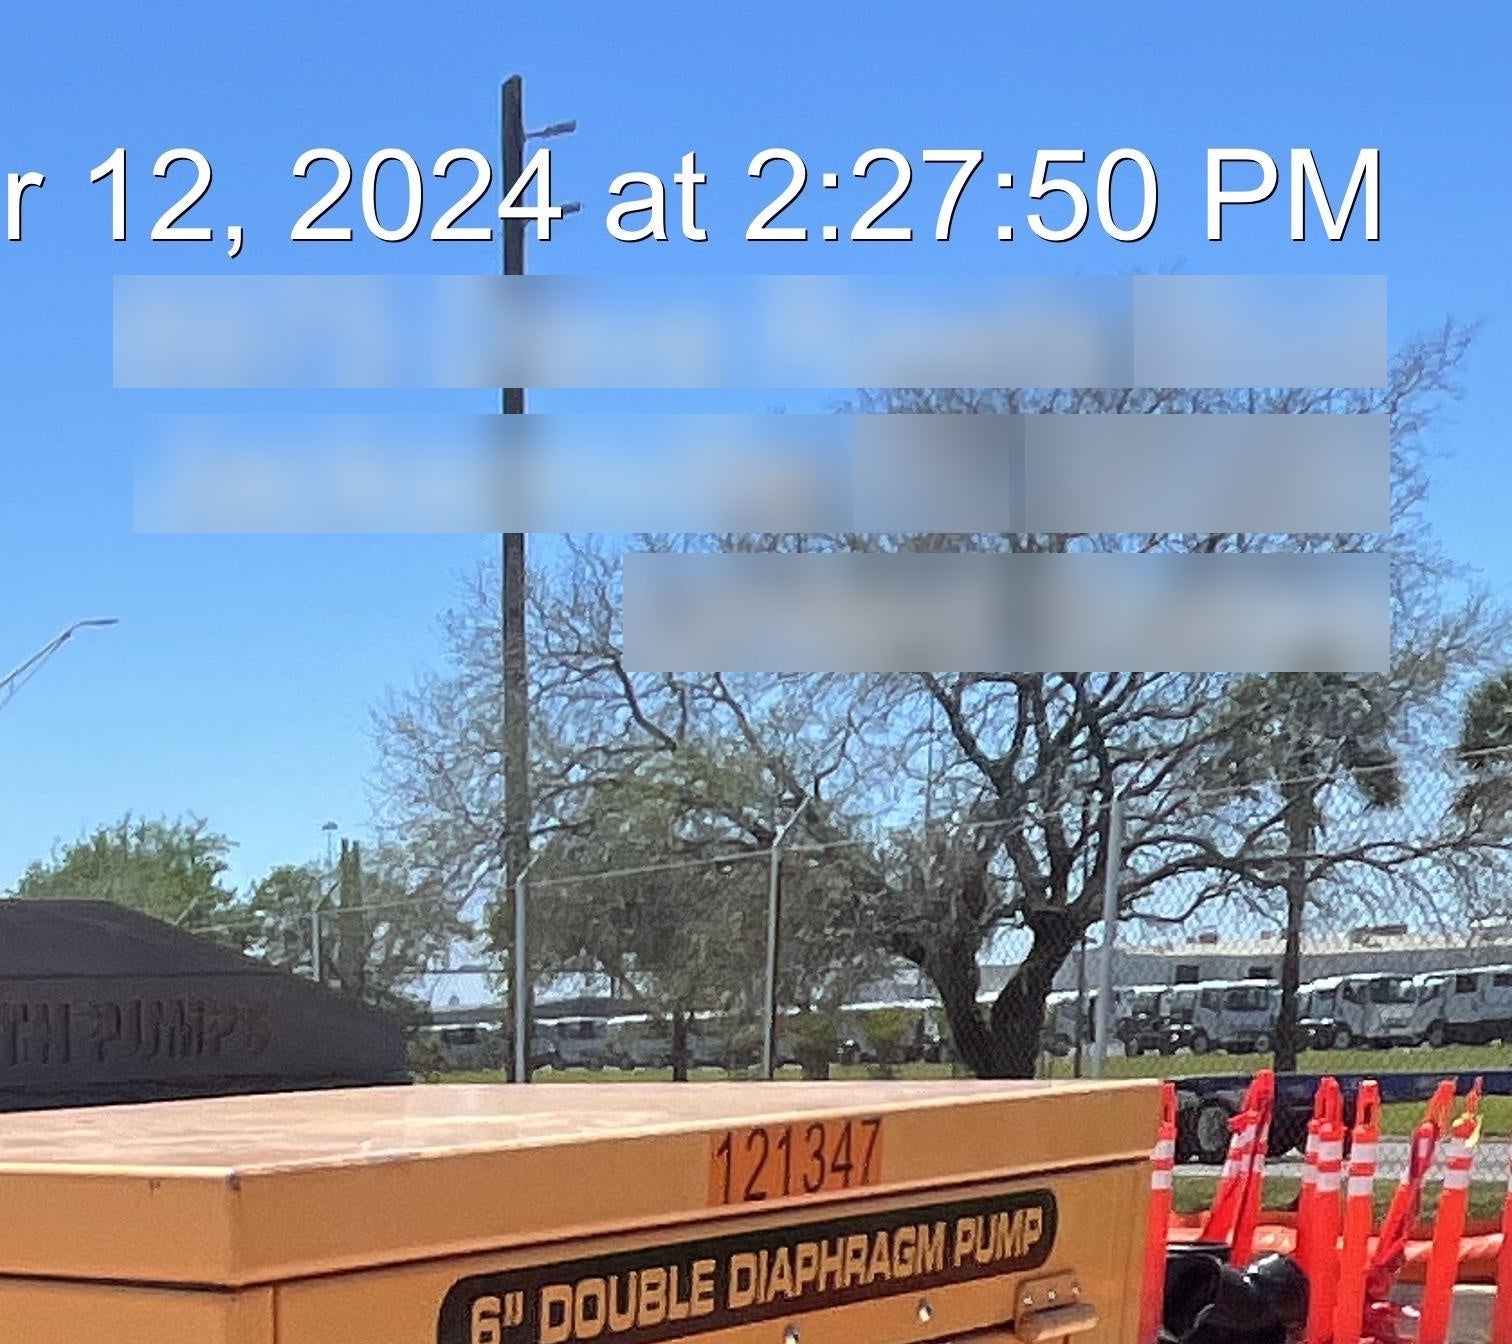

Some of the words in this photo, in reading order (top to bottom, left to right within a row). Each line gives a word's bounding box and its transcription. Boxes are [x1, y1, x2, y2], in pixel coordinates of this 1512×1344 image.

[716, 1117, 881, 1204] 121347
[728, 1221, 946, 1308] DIAPHRAGM
[953, 1206, 1043, 1267] PUMP
